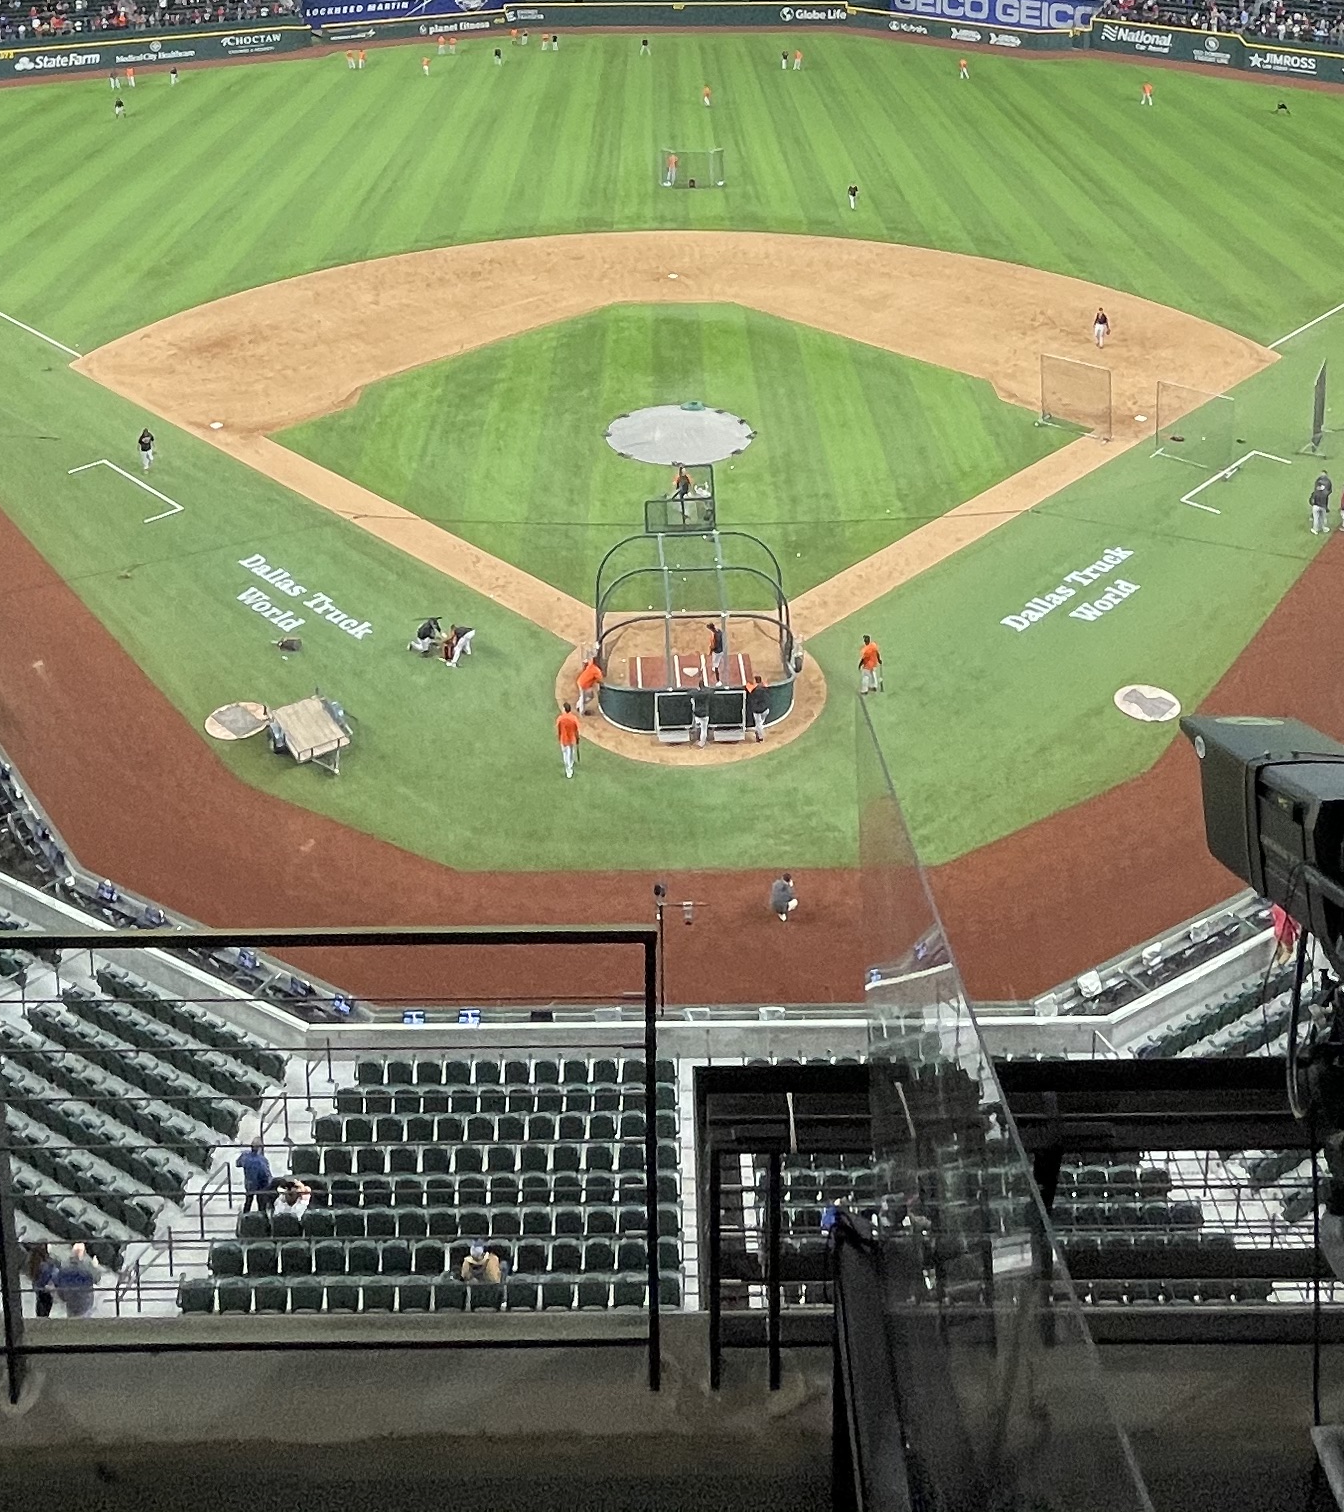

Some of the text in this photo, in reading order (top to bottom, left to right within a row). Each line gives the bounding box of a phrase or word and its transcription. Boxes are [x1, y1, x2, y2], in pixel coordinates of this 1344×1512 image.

[306, 1, 409, 17] LOCKHEED MARTIN
[795, 8, 825, 20] Globe
[827, 8, 847, 20] Life
[429, 22, 457, 35] planet
[1117, 27, 1173, 48] National
[225, 32, 282, 47] CHOCTAW
[116, 49, 196, 65] Medical City Healthcare
[238, 553, 373, 640] Dallas Truck
[999, 546, 1135, 633] Dallas Truck
[236, 586, 307, 633] World
[1068, 579, 1142, 622] World
